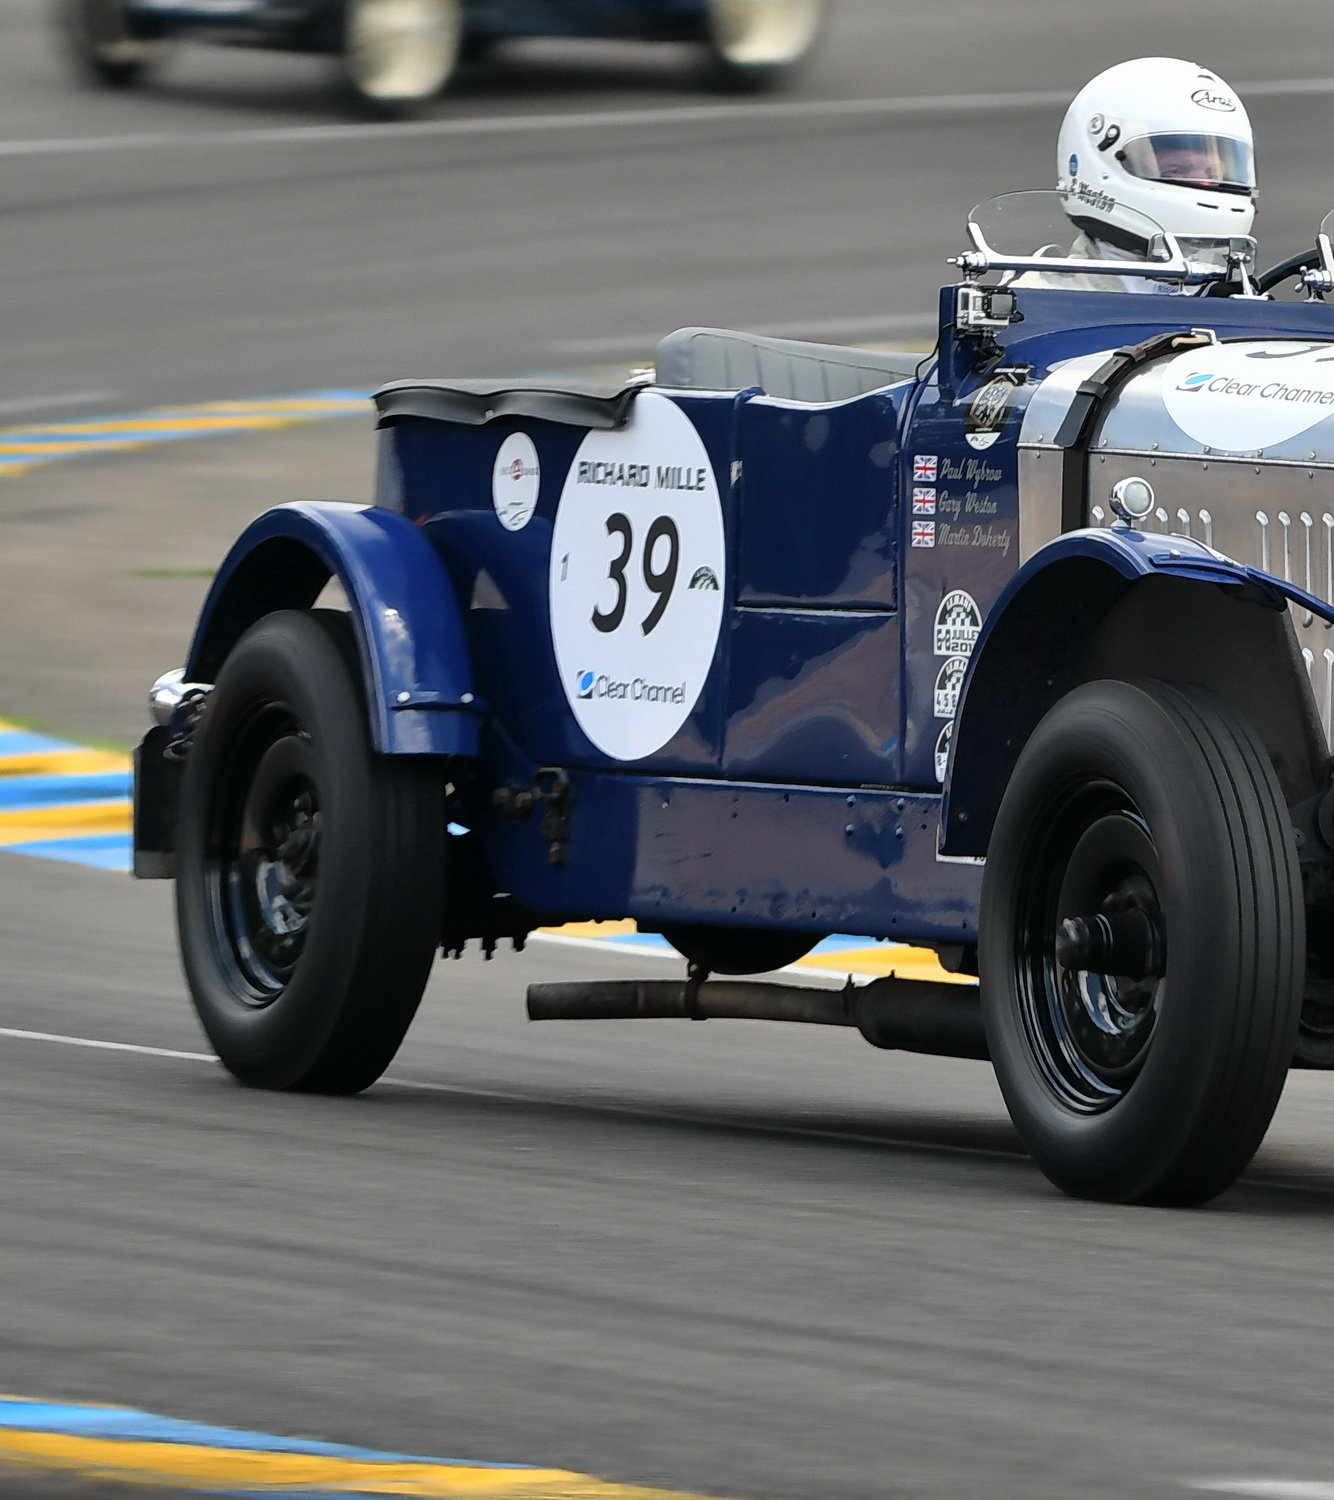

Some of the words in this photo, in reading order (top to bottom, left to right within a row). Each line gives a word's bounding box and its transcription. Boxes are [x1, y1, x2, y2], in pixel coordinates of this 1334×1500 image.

[1207, 376, 1261, 397] Clear
[577, 460, 650, 488] RICHARD
[654, 465, 707, 491] MILLE
[939, 457, 966, 481] Paul
[938, 490, 962, 522] Gary
[964, 490, 998, 515] Weston
[937, 522, 970, 546] Martin
[971, 524, 1011, 557] Doherty
[590, 512, 680, 638] 39
[951, 642, 973, 653] 201
[597, 673, 630, 700] Clear
[630, 676, 687, 705] Channel
